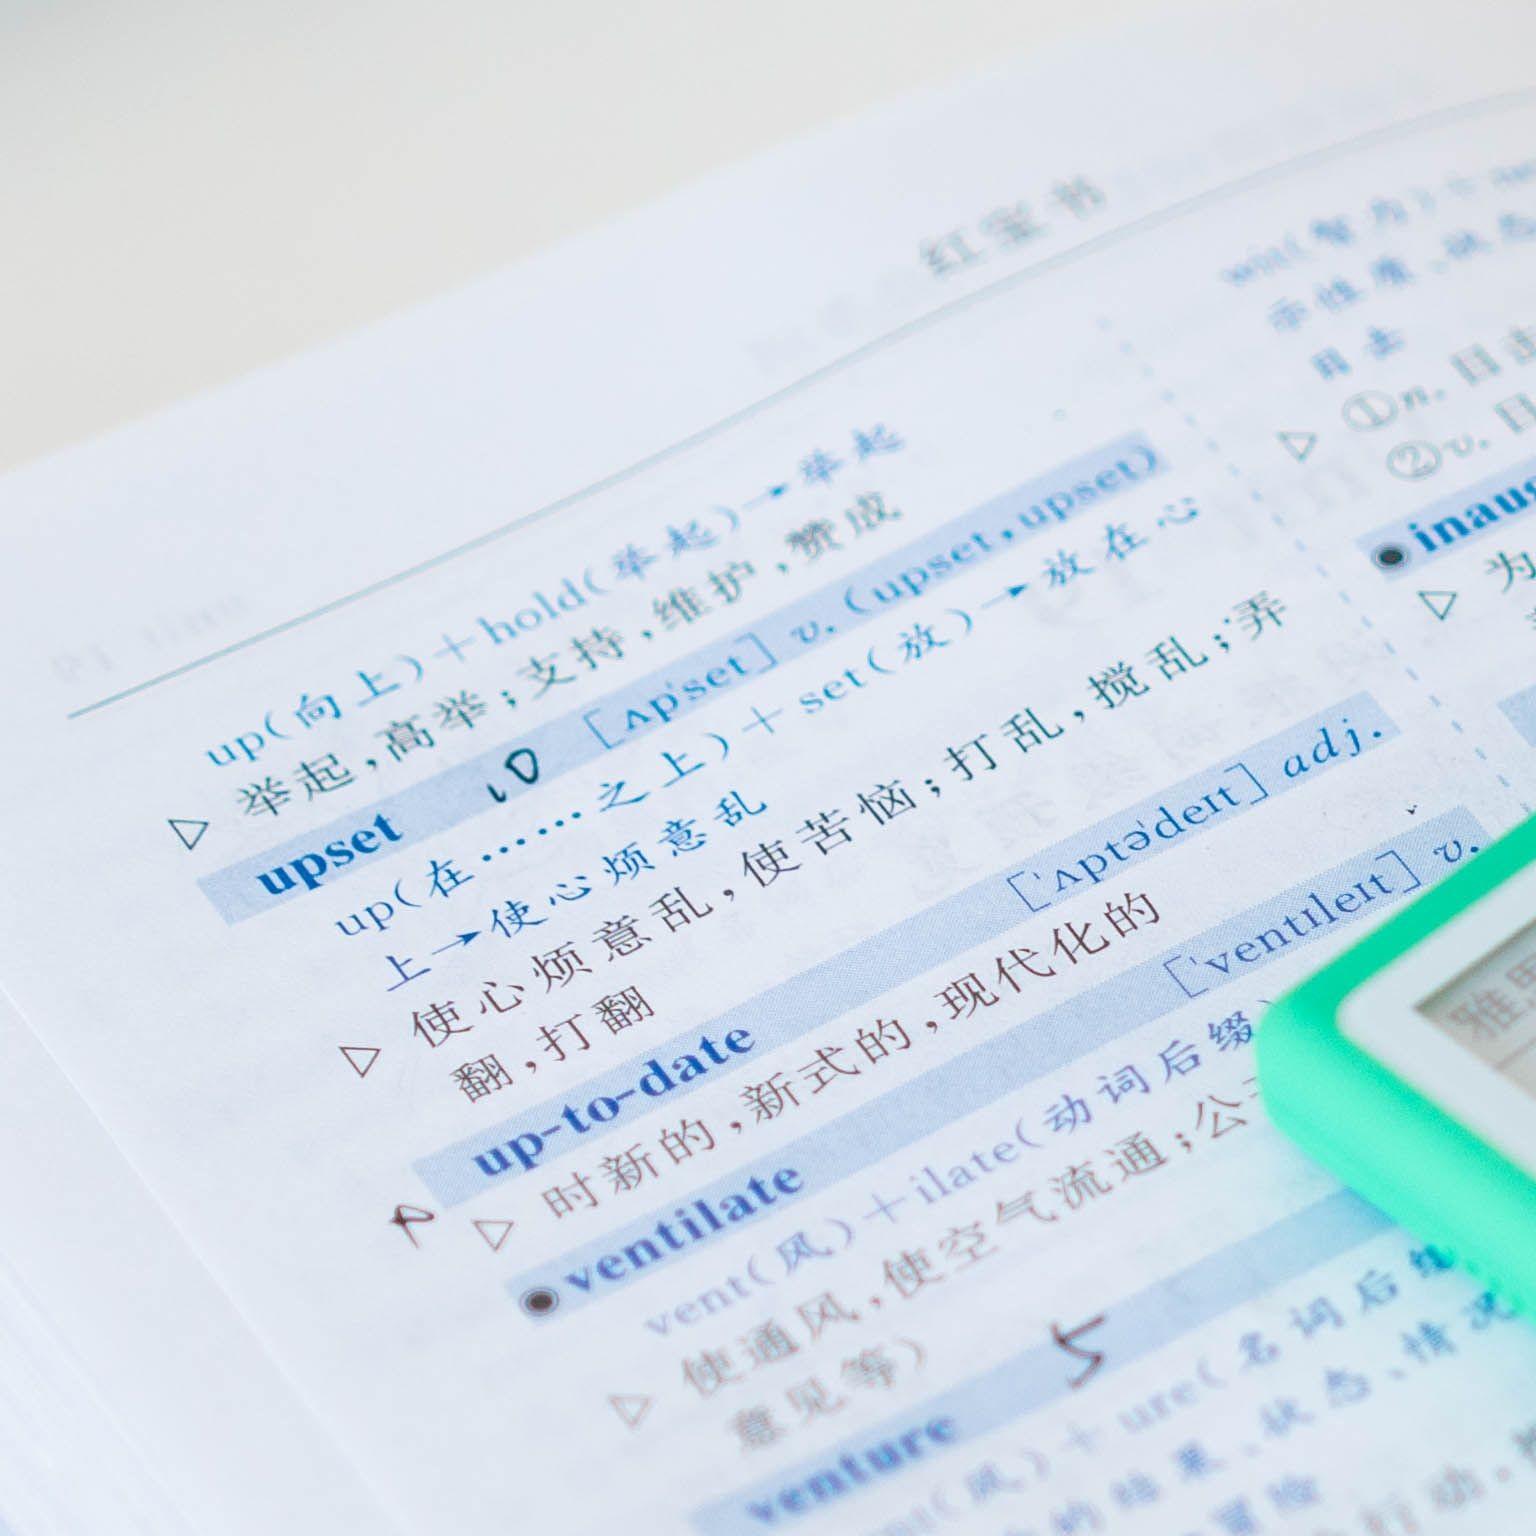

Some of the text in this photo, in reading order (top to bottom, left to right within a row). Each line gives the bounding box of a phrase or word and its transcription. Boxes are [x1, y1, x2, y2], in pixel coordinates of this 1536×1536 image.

[253, 811, 404, 898] upset
[470, 1023, 757, 1182] up-to-date
[564, 1163, 804, 1296] ventilate
[749, 1413, 955, 1525] venture
